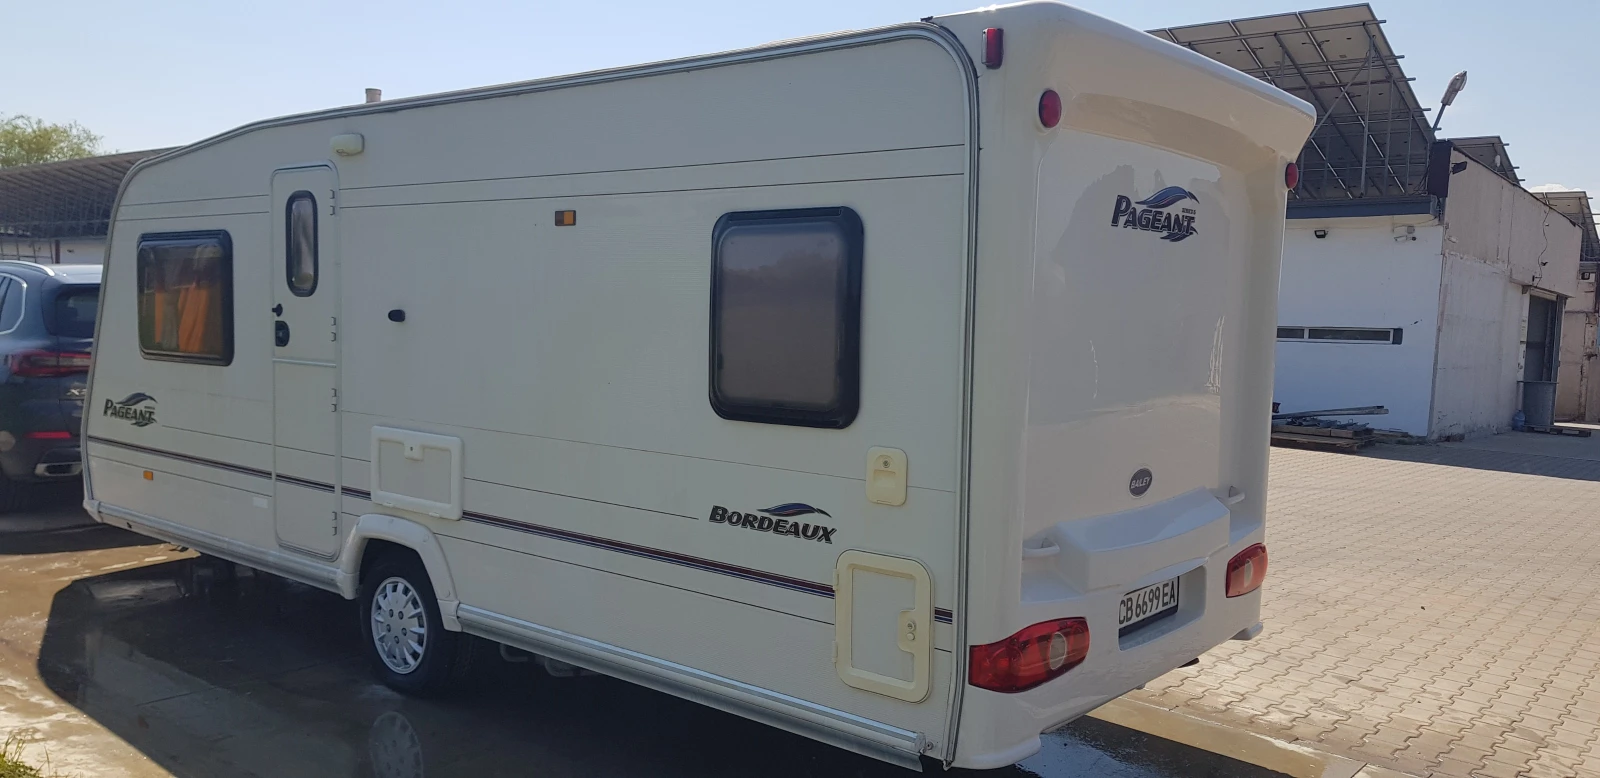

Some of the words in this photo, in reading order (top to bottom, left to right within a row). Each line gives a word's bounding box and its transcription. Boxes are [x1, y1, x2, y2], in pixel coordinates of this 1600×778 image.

[1111, 194, 1195, 235] PAGEANT
[103, 398, 155, 422] PAGEANT
[1130, 476, 1151, 489] BAILEY
[709, 505, 837, 545] BORDEAUX
[1118, 597, 1133, 625] CB
[1135, 586, 1161, 618] 6699
[1162, 580, 1176, 608] EA
